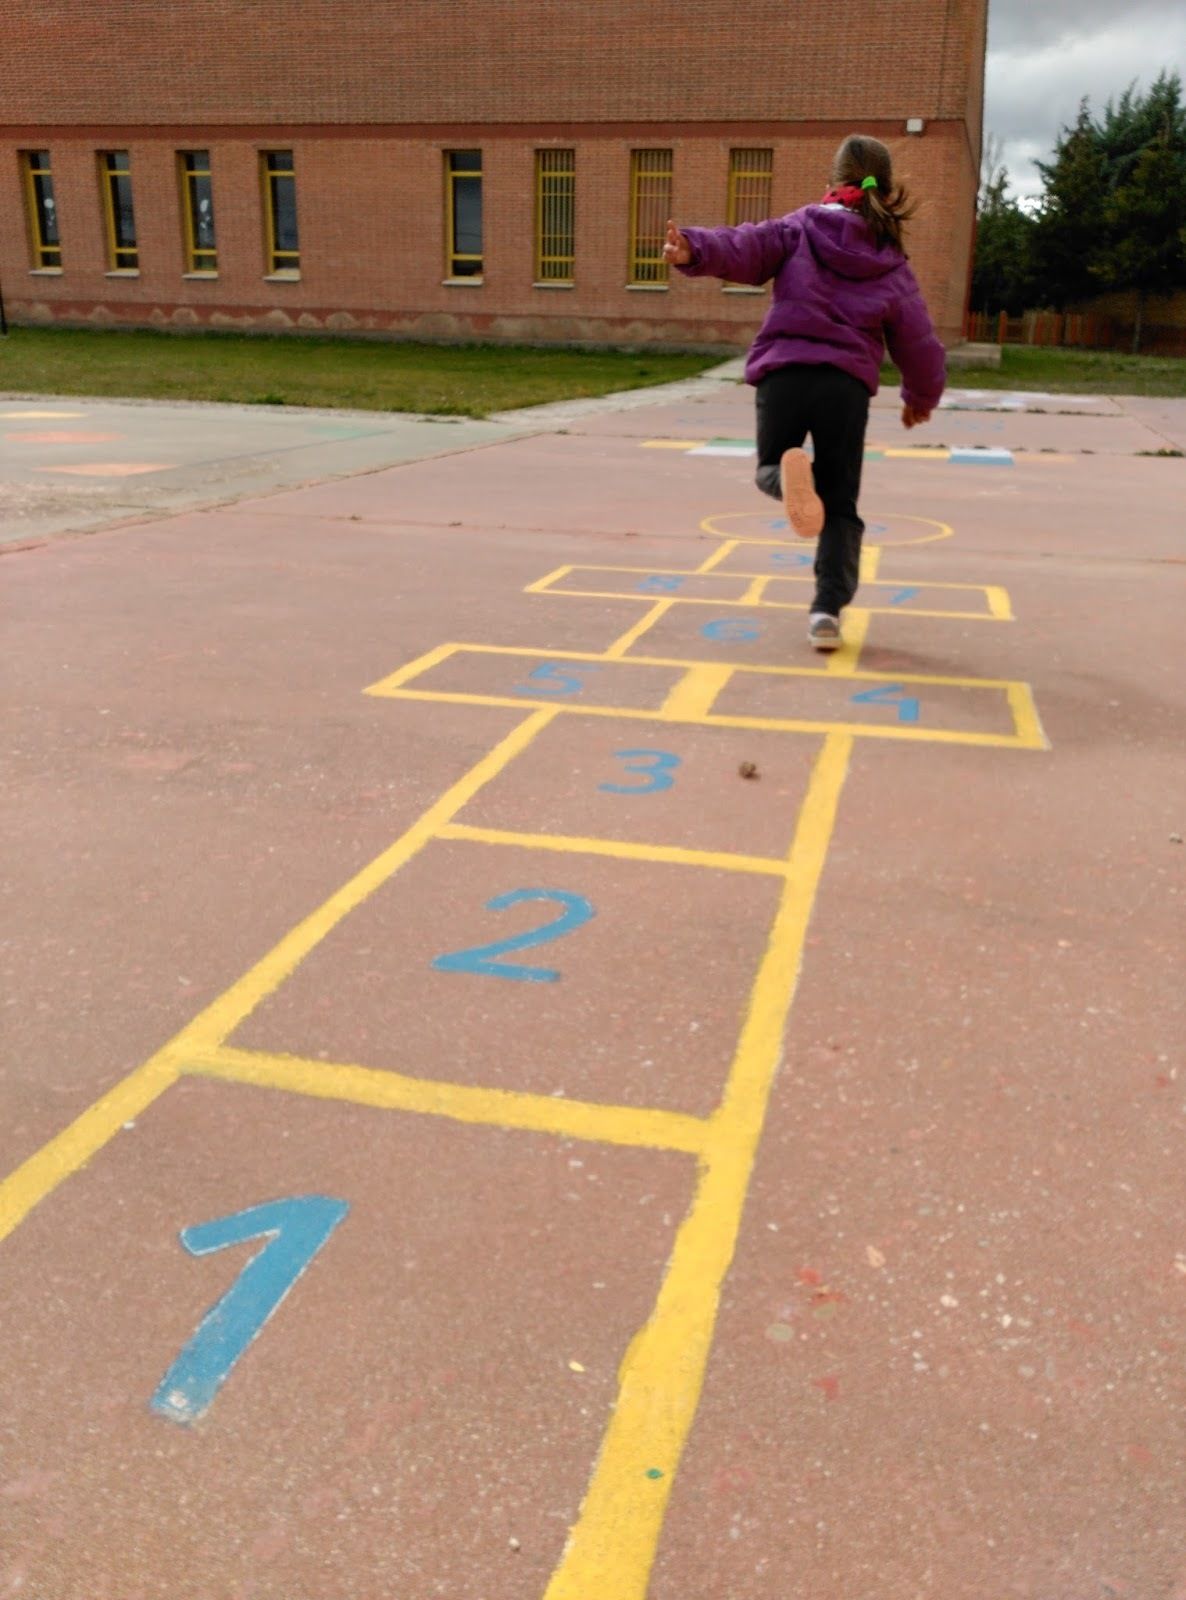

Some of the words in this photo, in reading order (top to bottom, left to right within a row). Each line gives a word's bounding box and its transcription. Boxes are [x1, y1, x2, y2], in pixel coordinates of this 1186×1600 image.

[635, 574, 685, 591] 8
[879, 586, 921, 604] 7
[700, 617, 762, 643] 6
[514, 661, 598, 697] 5
[851, 684, 921, 722] 4
[599, 750, 682, 795] 3
[432, 887, 596, 984] 2
[150, 1194, 350, 1426] 1
